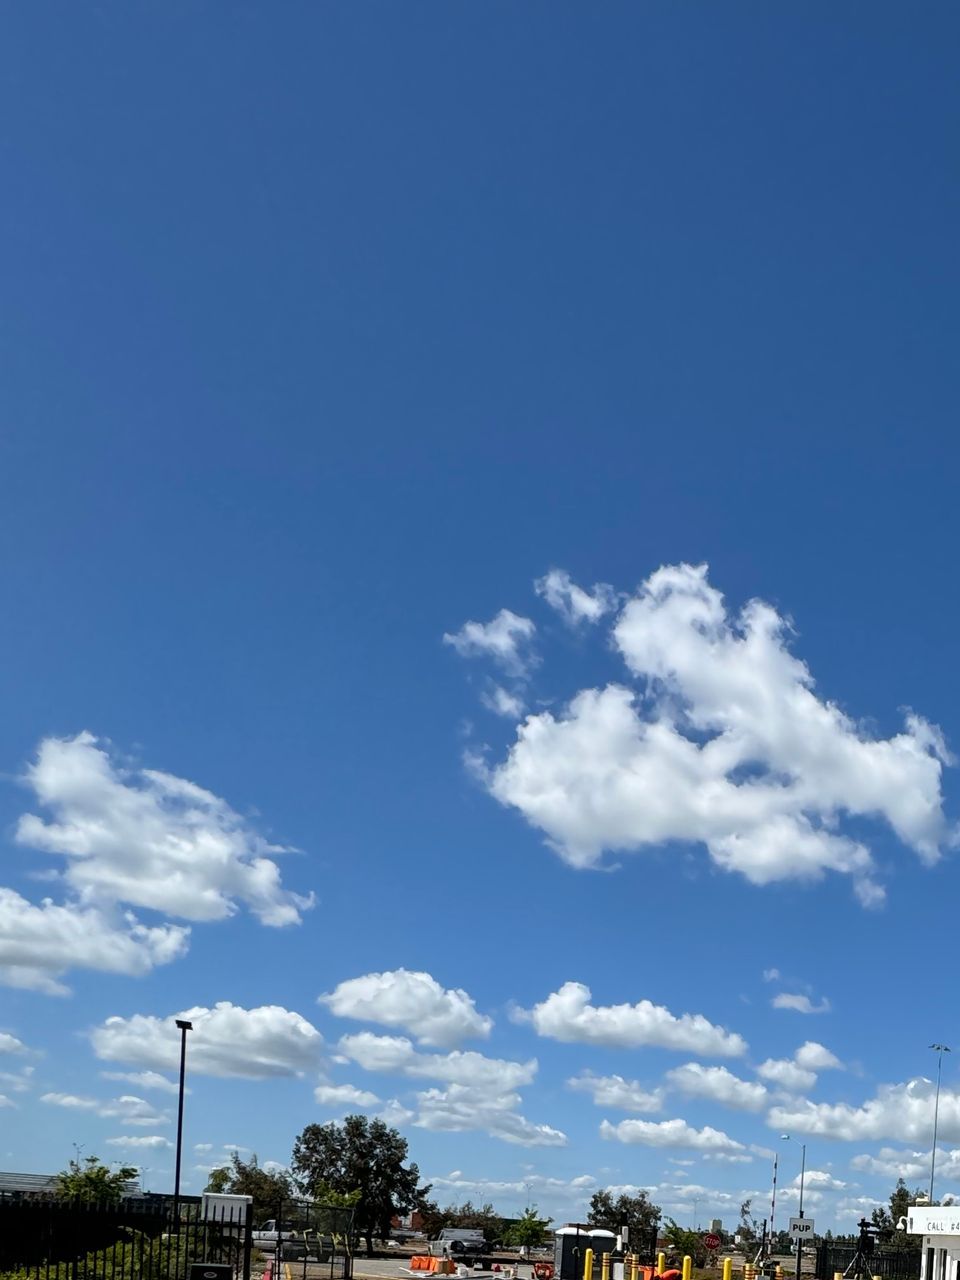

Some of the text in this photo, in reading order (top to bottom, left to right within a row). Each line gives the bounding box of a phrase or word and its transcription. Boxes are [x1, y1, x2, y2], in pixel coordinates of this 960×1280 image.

[793, 1224, 811, 1232] PUP
[927, 1222, 944, 1231] CALL
[705, 1237, 720, 1246] STOP
